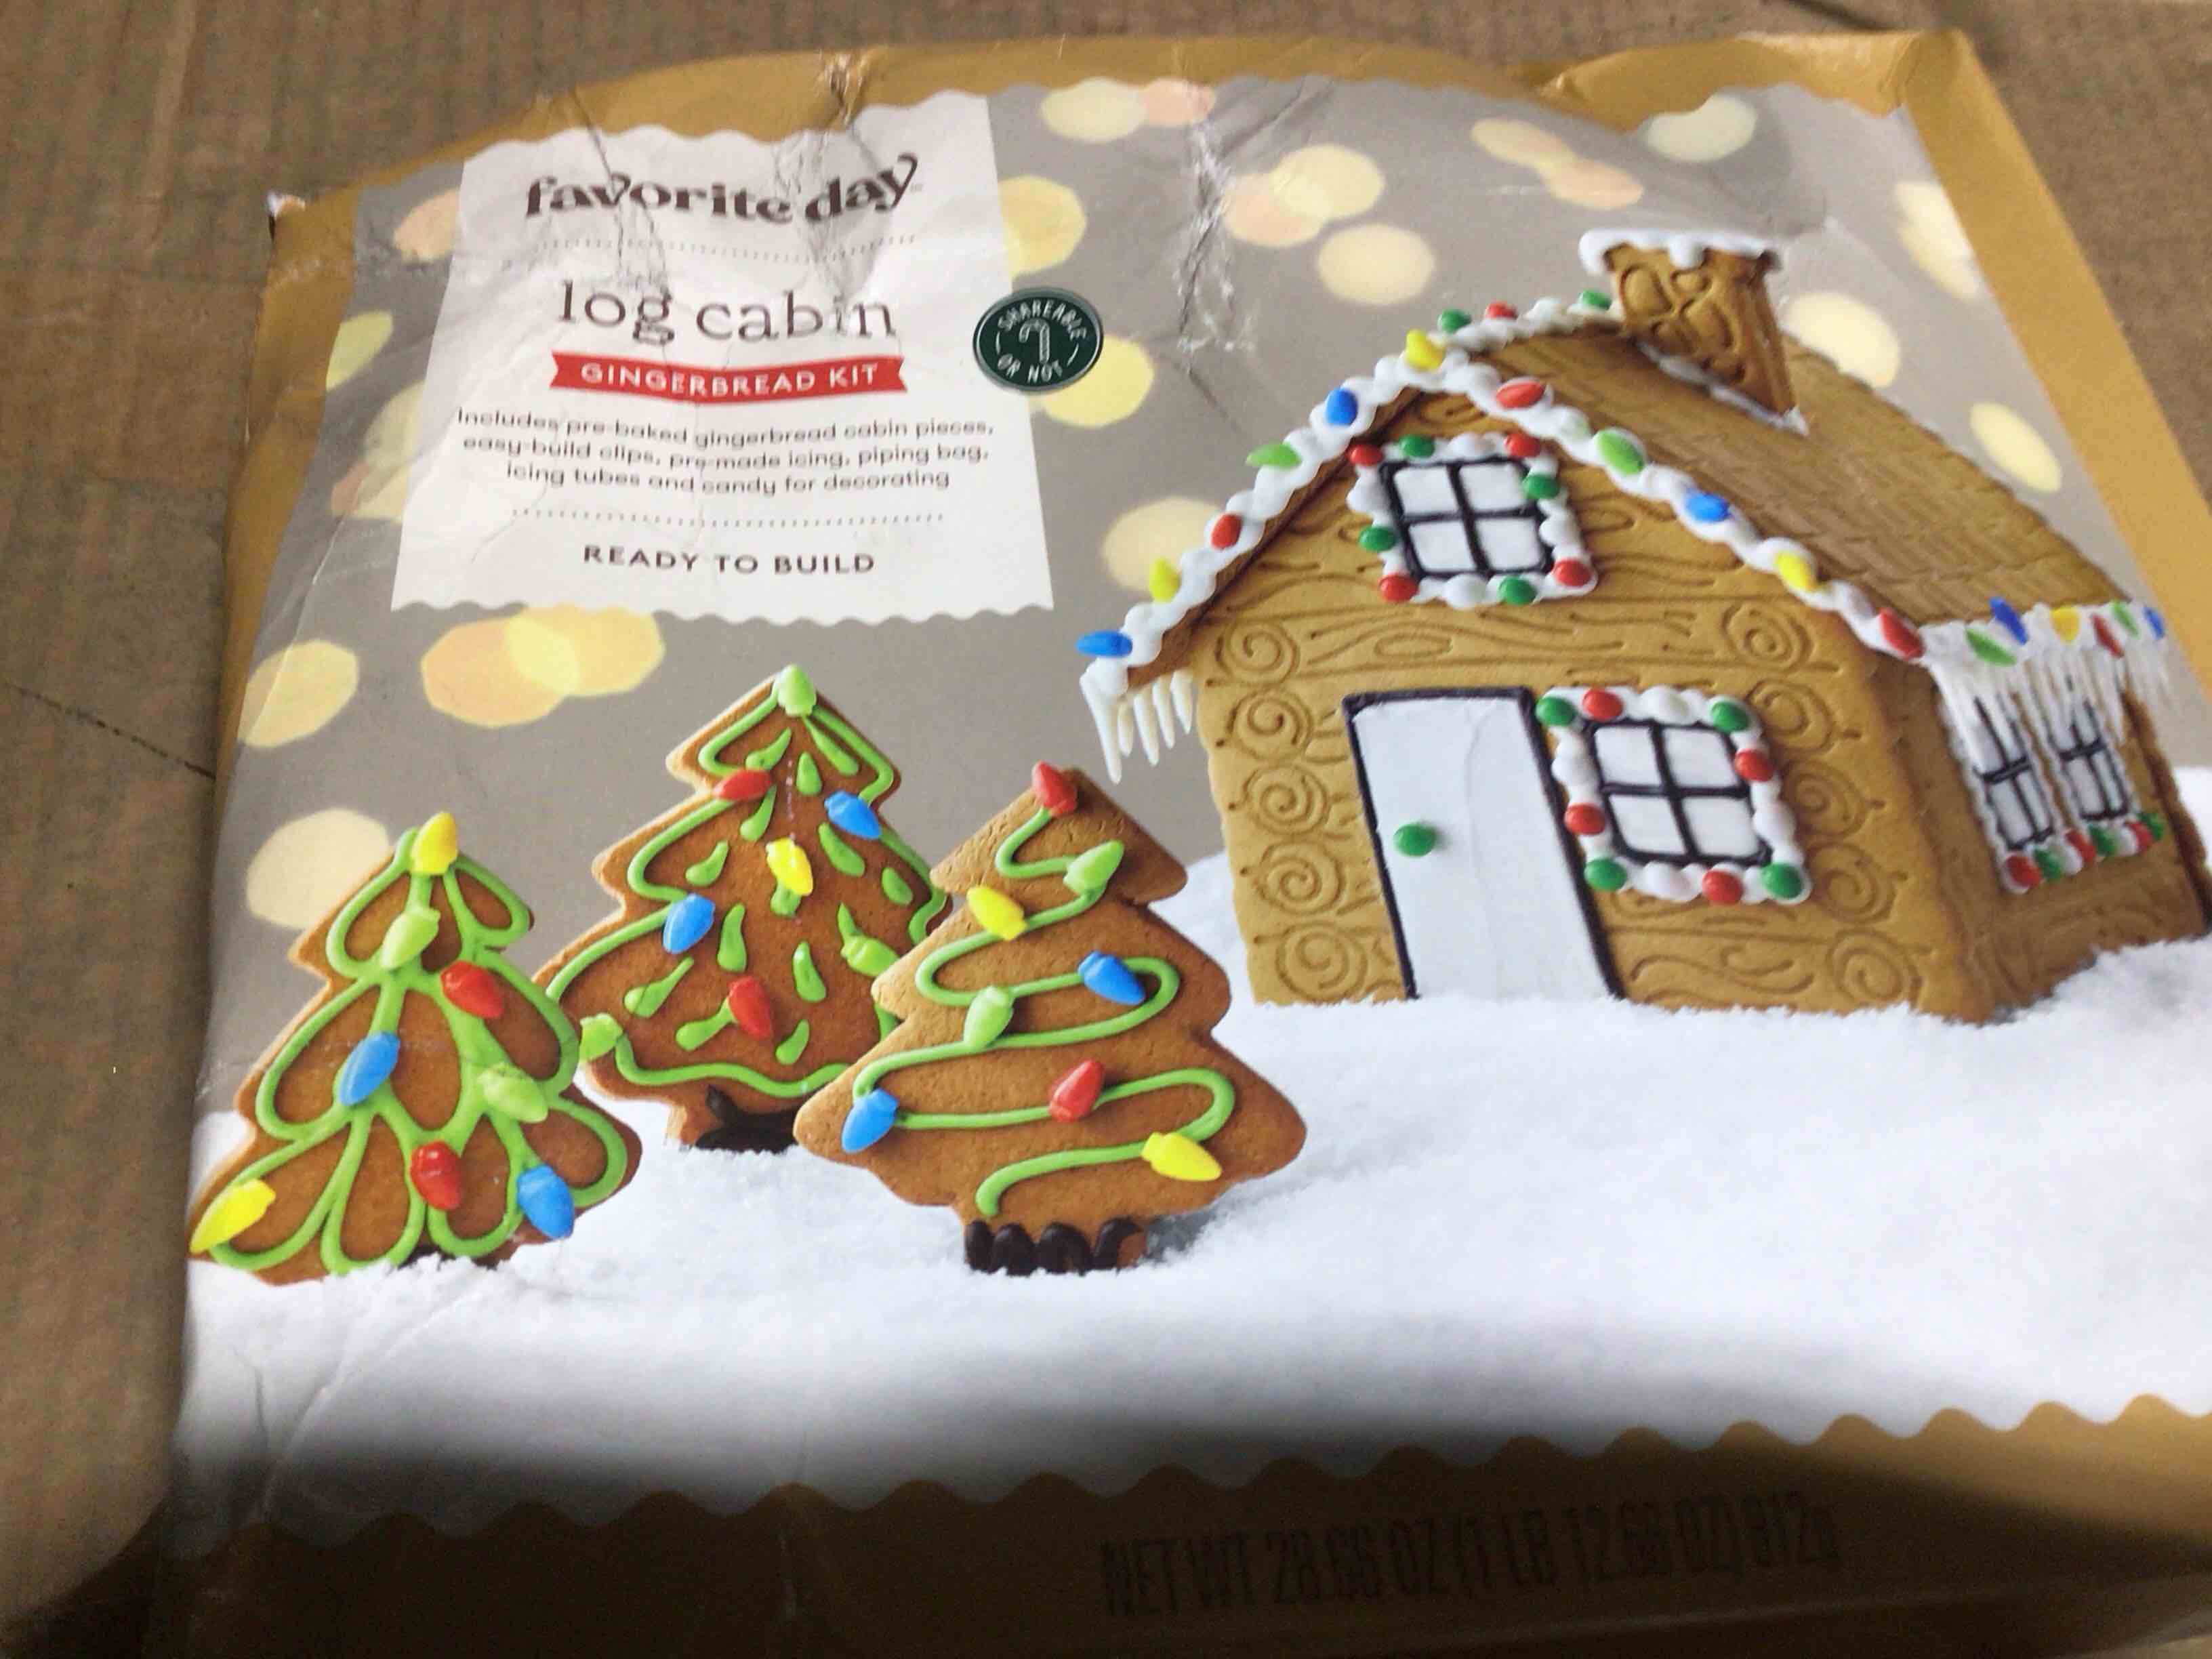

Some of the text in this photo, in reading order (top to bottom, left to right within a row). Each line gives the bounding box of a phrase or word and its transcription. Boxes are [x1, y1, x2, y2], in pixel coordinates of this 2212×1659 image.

[526, 152, 918, 223] favorite day
[558, 280, 897, 345] log cabin
[581, 362, 878, 396] GINGERBREAD KIT
[1027, 359, 1063, 384] NOT
[457, 407, 994, 450] Includes pre-baked gingerbread cabin pieces,
[463, 436, 591, 458] easy-build
[600, 448, 661, 466] clips,
[789, 450, 851, 469] icing,
[858, 444, 930, 466] piping
[937, 443, 989, 463] bag,
[507, 460, 950, 498] icing tubes and candy for decorating
[583, 545, 875, 575] READY TO BUILD
[1098, 1540, 1181, 1617] NET
[1185, 1533, 1255, 1607] WT
[1388, 1518, 1448, 1597] OZ
[1502, 1506, 1556, 1589] LB
